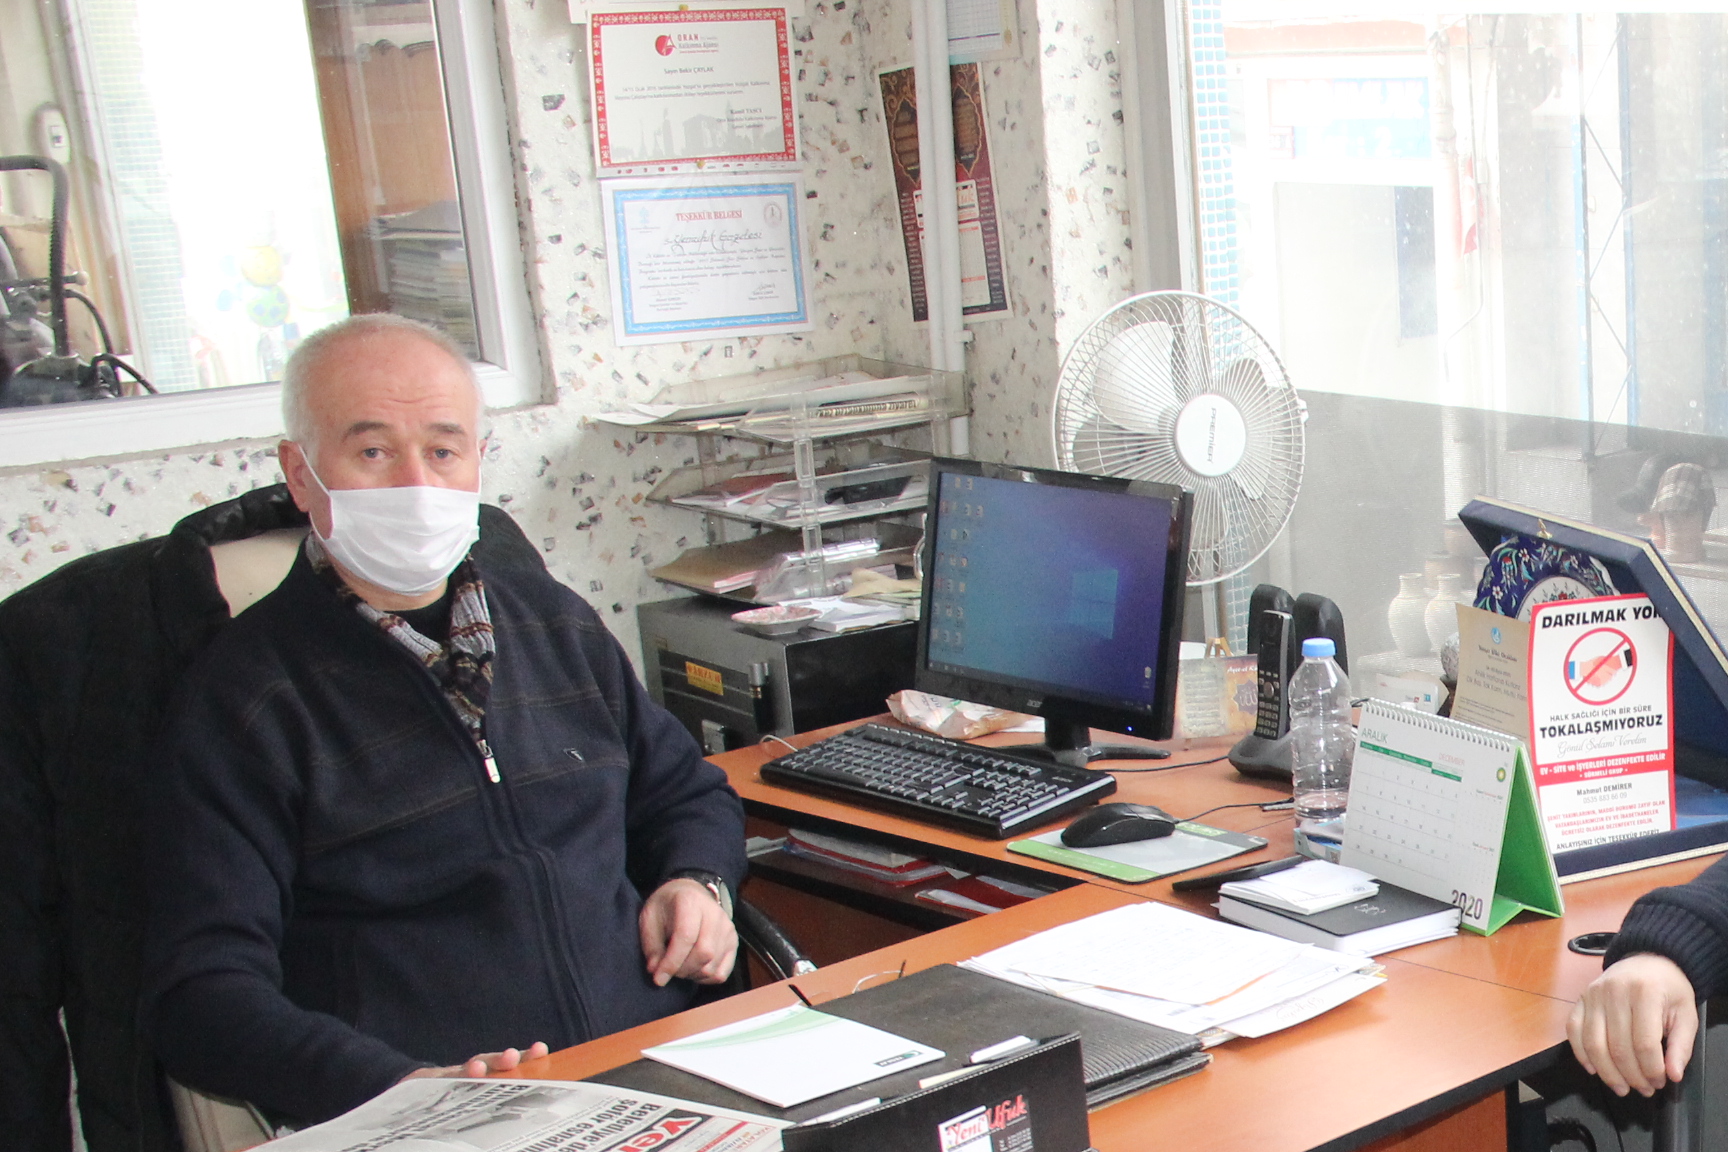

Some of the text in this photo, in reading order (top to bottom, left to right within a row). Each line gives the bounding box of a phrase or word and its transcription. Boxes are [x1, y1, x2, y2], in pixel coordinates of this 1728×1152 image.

[1541, 608, 1627, 629] DARILMAK
[1550, 704, 1652, 722] HALK SAĞLIĞI İÇİN BİR SÜRE
[1361, 728, 1389, 744] ARALIK
[1540, 714, 1663, 739] TOKALAŞMIYORUZ
[1540, 767, 1549, 776] EV
[1553, 764, 1567, 774] SİTE
[1576, 759, 1606, 772] İŞYERLERİ
[1607, 756, 1645, 767] DEZENFEKTE
[1646, 752, 1666, 762] EDİLİR
[1576, 782, 1632, 796] Mahmut DEMİRER
[1556, 838, 1593, 850] ANLAYIŞINIZ
[1594, 835, 1607, 845] İÇİN
[1451, 889, 1483, 920] 2020
[589, 1099, 639, 1123] şoför
[947, 1116, 984, 1145] Yeni
[984, 1094, 1027, 1130] Ufuk
